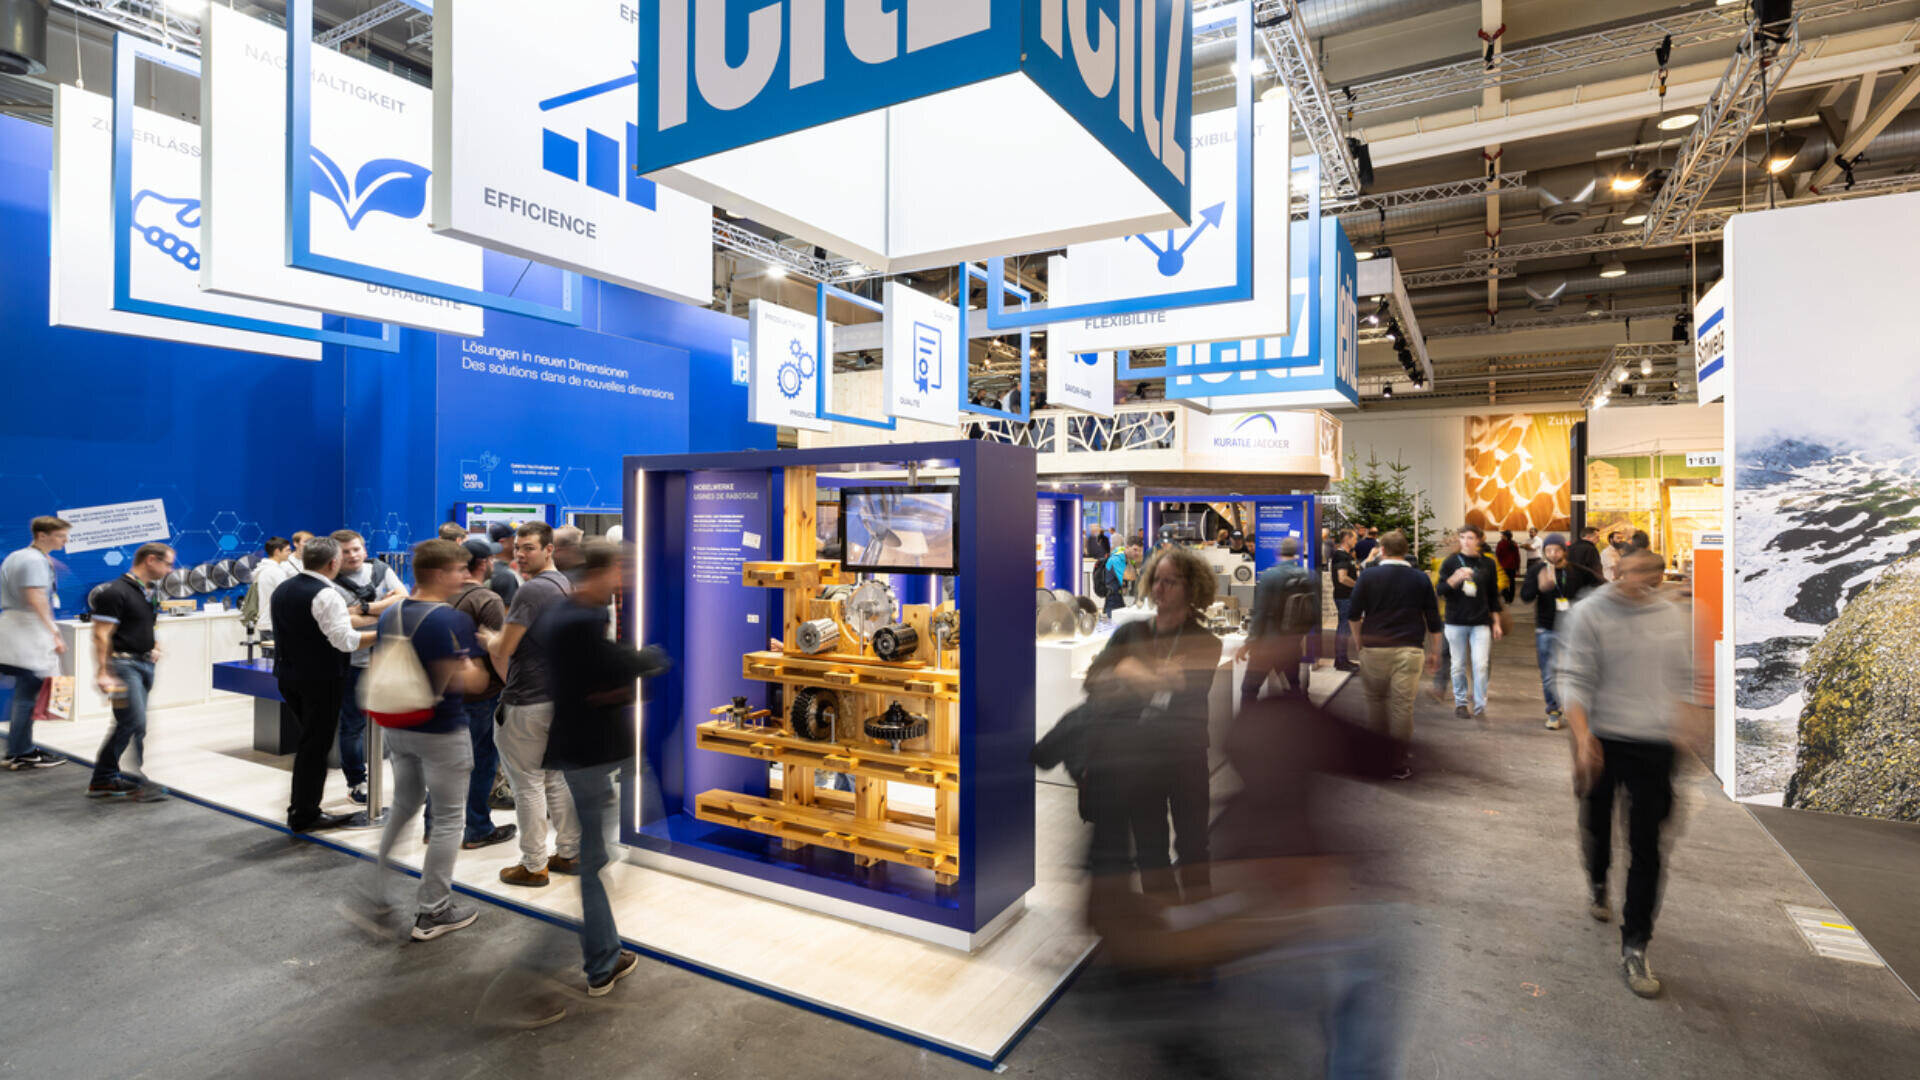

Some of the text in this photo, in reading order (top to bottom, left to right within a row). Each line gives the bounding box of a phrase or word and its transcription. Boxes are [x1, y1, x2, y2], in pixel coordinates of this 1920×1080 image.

[244, 43, 406, 114] NACALTIGKEIT
[484, 187, 597, 239] EFFICIENCE
[462, 339, 629, 379] Lösungen in neuen Dimensionen
[462, 356, 674, 401] Des solutions dans de nouvelles dimensions
[733, 346, 750, 383] lei
[1213, 437, 1252, 448] KURATLE
[463, 481, 484, 489] care
